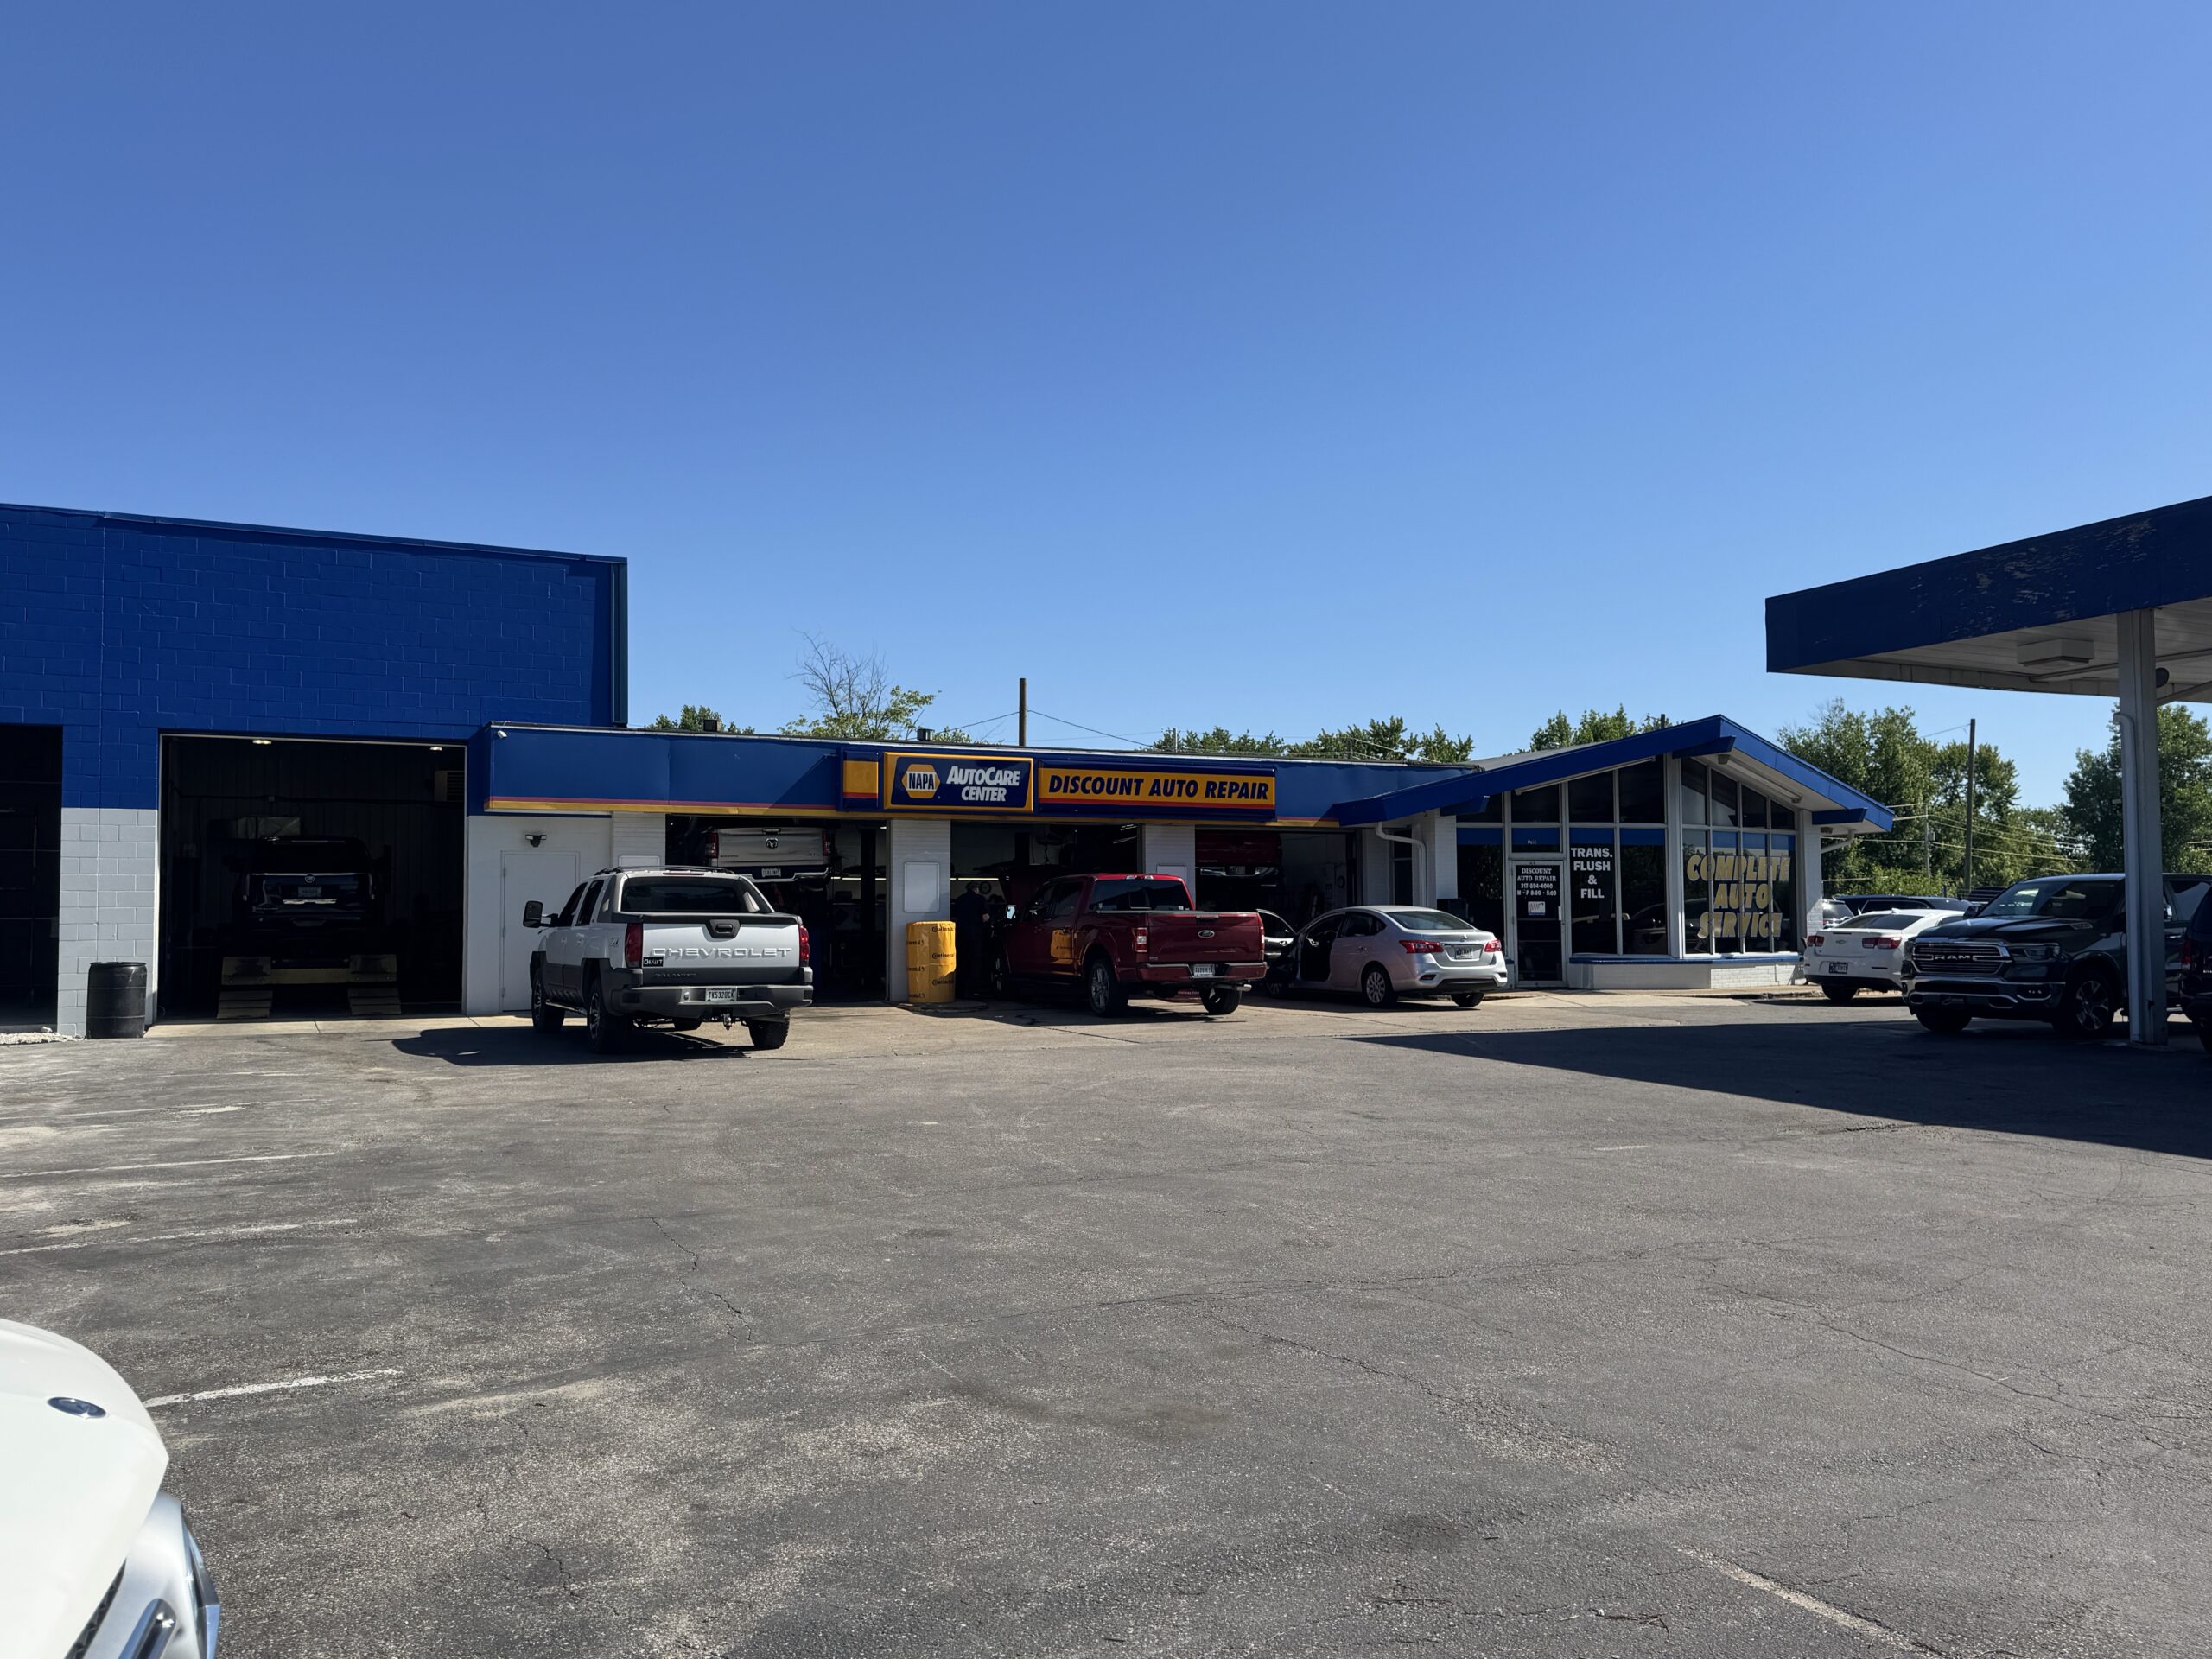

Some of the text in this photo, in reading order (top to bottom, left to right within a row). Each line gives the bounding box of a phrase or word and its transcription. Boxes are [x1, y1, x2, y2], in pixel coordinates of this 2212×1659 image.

[908, 772, 935, 790] NAPA
[1048, 774, 1269, 800] DISCOUNT AUTO REPAIR
[961, 786, 1007, 802] CENTER
[1570, 847, 1613, 858] TRANS.
[1573, 861, 1611, 871] FLUSH
[1687, 855, 1791, 882] COMPLETE
[1587, 874, 1598, 885] &
[1580, 888, 1605, 899] FILL
[1713, 883, 1770, 910] AUTO
[1697, 912, 1783, 939] SERVICE
[652, 948, 793, 957] CHEVROLET
